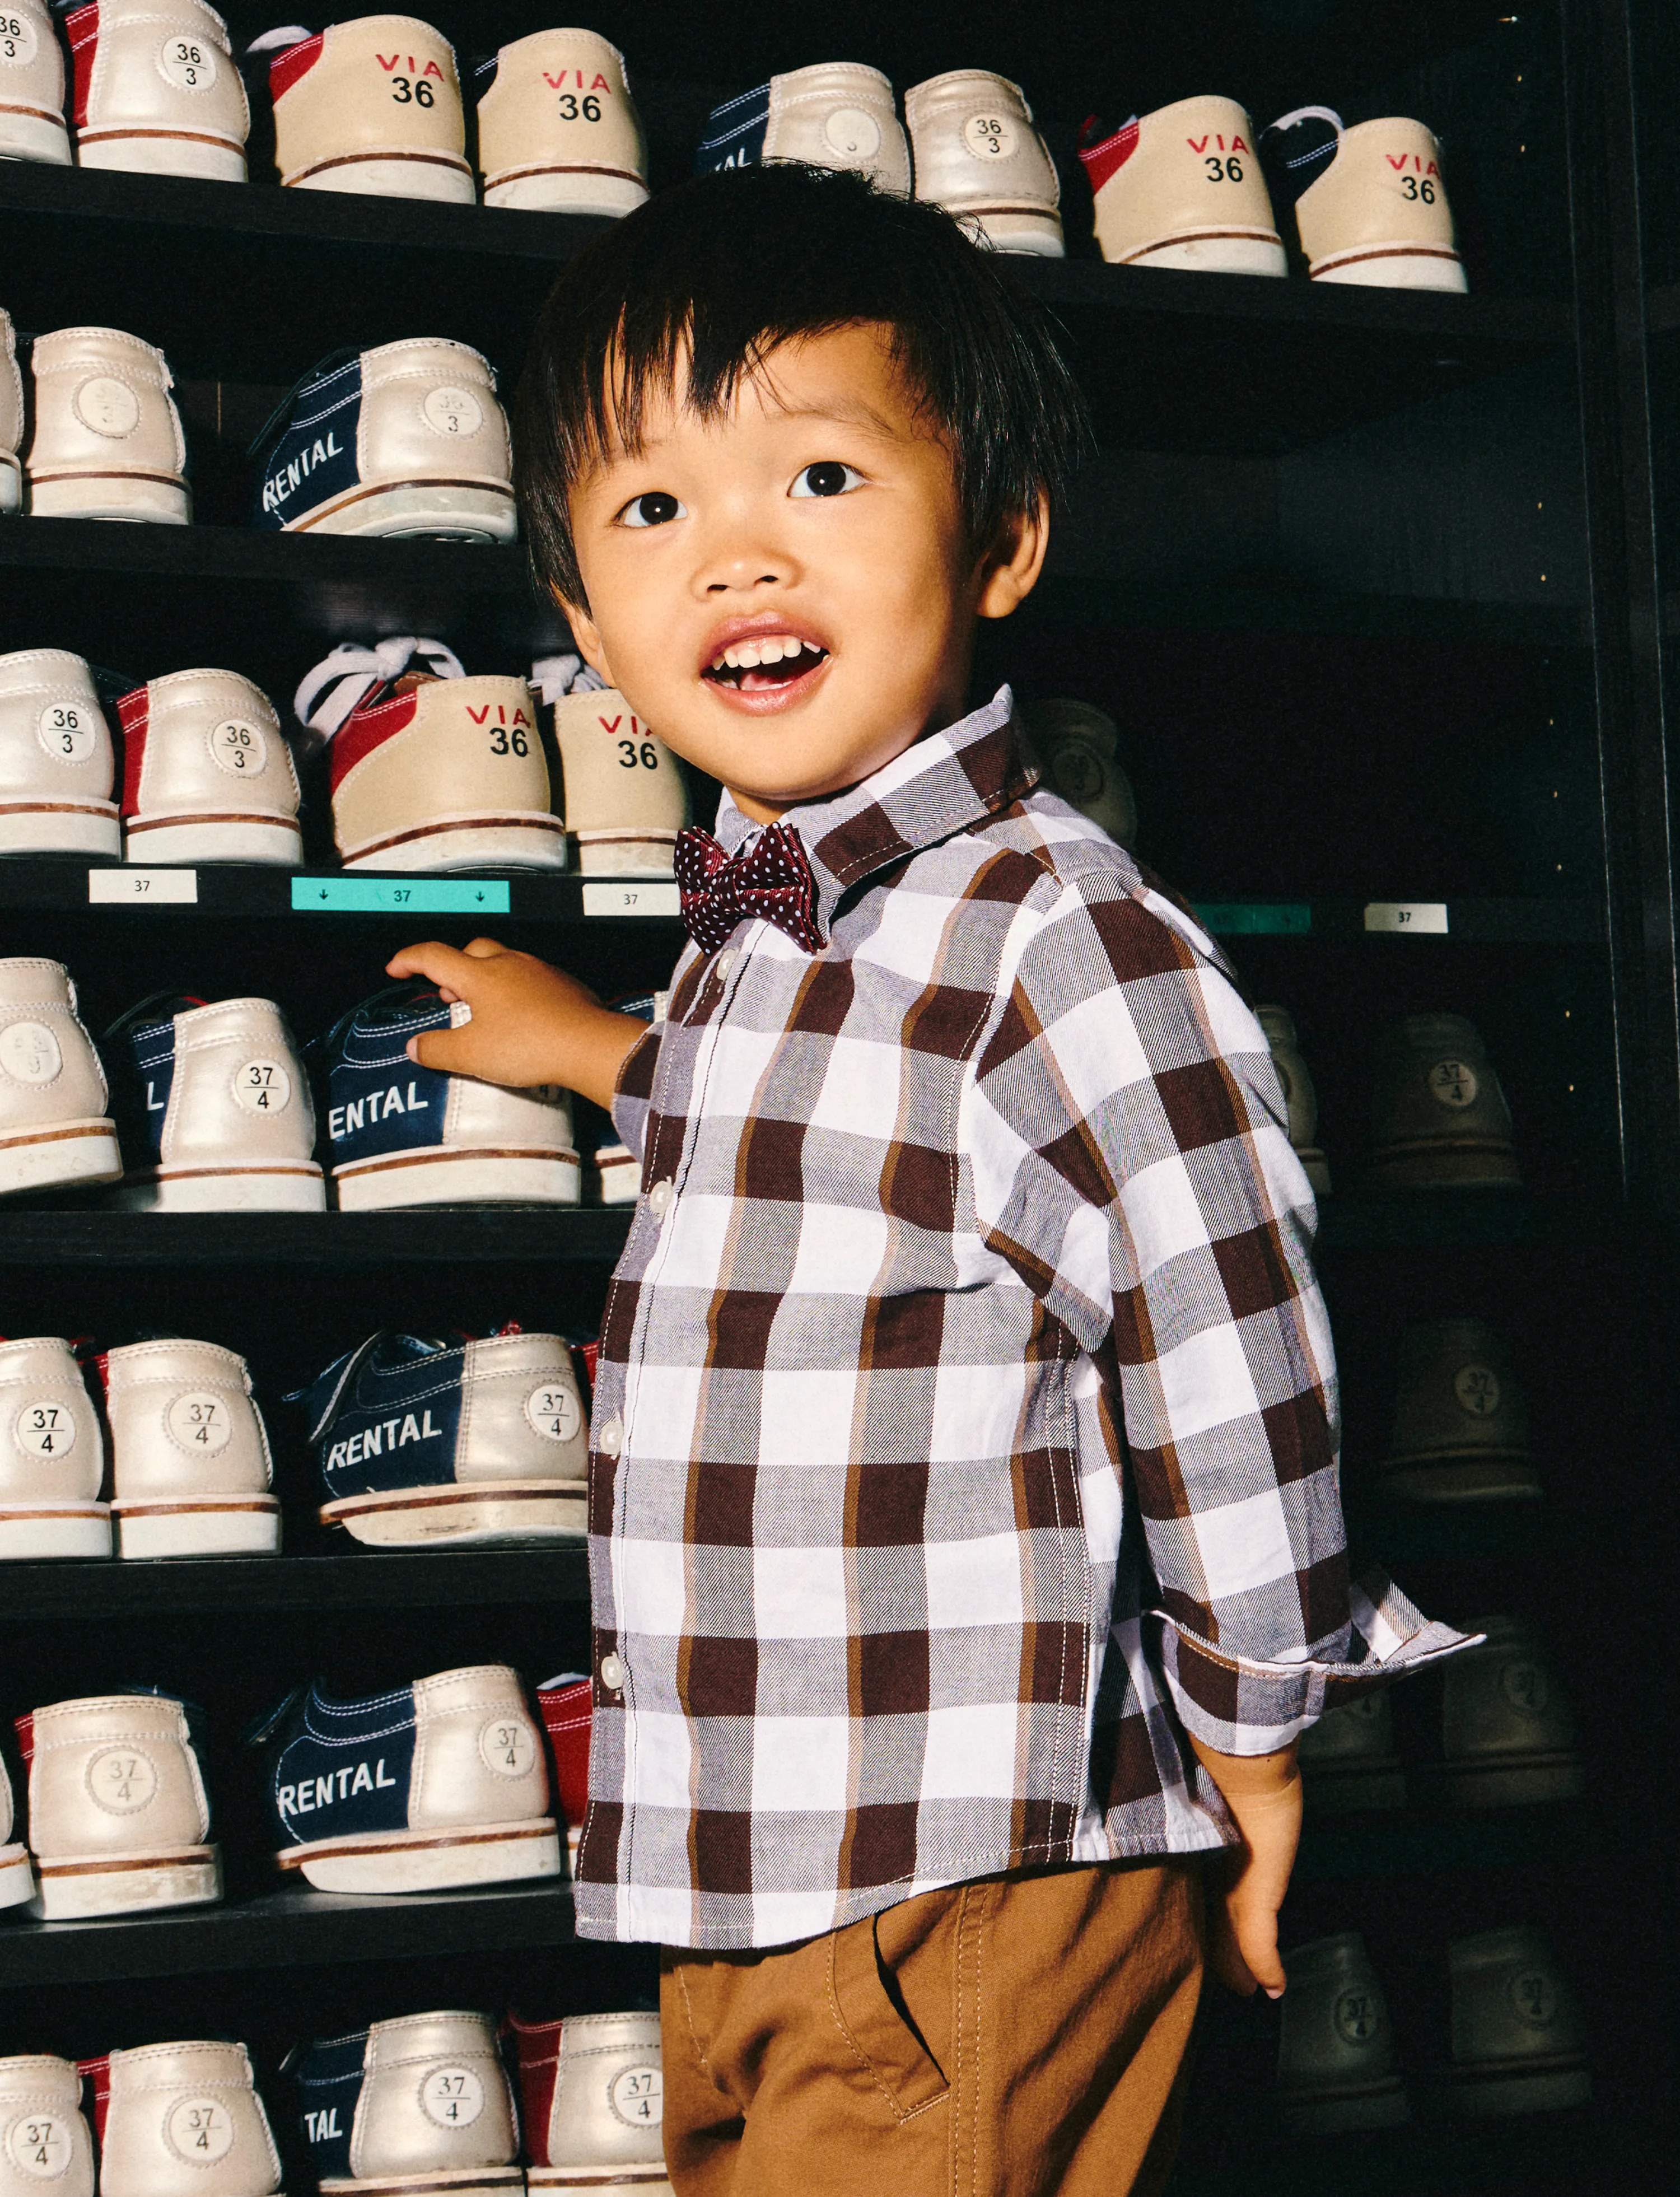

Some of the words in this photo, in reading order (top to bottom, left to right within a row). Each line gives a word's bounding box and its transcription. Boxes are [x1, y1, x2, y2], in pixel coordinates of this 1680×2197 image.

[0, 16, 21, 36] 36
[4, 40, 16, 58] 3
[177, 44, 201, 64] 36
[186, 68, 197, 85] 3
[376, 54, 443, 81] VIA
[543, 70, 610, 92] VIA
[392, 77, 435, 108] 36
[559, 94, 601, 122] 36
[977, 119, 1002, 134] 36
[988, 137, 1000, 153] 3
[1187, 134, 1249, 155] VIA
[1205, 156, 1244, 183] 36
[1385, 153, 1441, 177] VIA
[1401, 175, 1435, 205] 36
[448, 416, 458, 432] 3
[263, 431, 344, 513] RENTAL
[53, 709, 78, 729] 36
[466, 704, 531, 730] VIA
[62, 734, 73, 753] 3
[227, 726, 251, 746] 36
[490, 727, 529, 757] 36
[235, 750, 245, 768] 3
[618, 740, 658, 770] 36
[135, 880, 150, 892] 37
[394, 890, 411, 902] 37
[624, 894, 638, 905] 37
[1398, 911, 1411, 923] 37
[250, 1067, 273, 1085] 37
[1438, 1062, 1460, 1079] 37
[258, 1091, 269, 1109] 4
[543, 1393, 564, 1411] 37
[33, 1409, 59, 1429] 37
[191, 1404, 216, 1422] 37
[195, 1426, 209, 1444] 4
[551, 1418, 562, 1435] 4
[41, 1434, 54, 1453] 4
[326, 1410, 442, 1471] RENTAL
[498, 1727, 518, 1747] 37
[506, 1748, 516, 1767] 4
[109, 1759, 138, 1779] 37
[117, 1781, 132, 1801] 4
[279, 1758, 396, 1817] RENTAL
[438, 2075, 465, 2096] 37
[628, 2074, 652, 2095] 37
[190, 2108, 214, 2130] 37
[447, 2102, 458, 2120] 4
[638, 2100, 651, 2118] 4
[27, 2123, 52, 2144] 37
[196, 2131, 209, 2150] 4
[35, 2146, 48, 2165] 4
